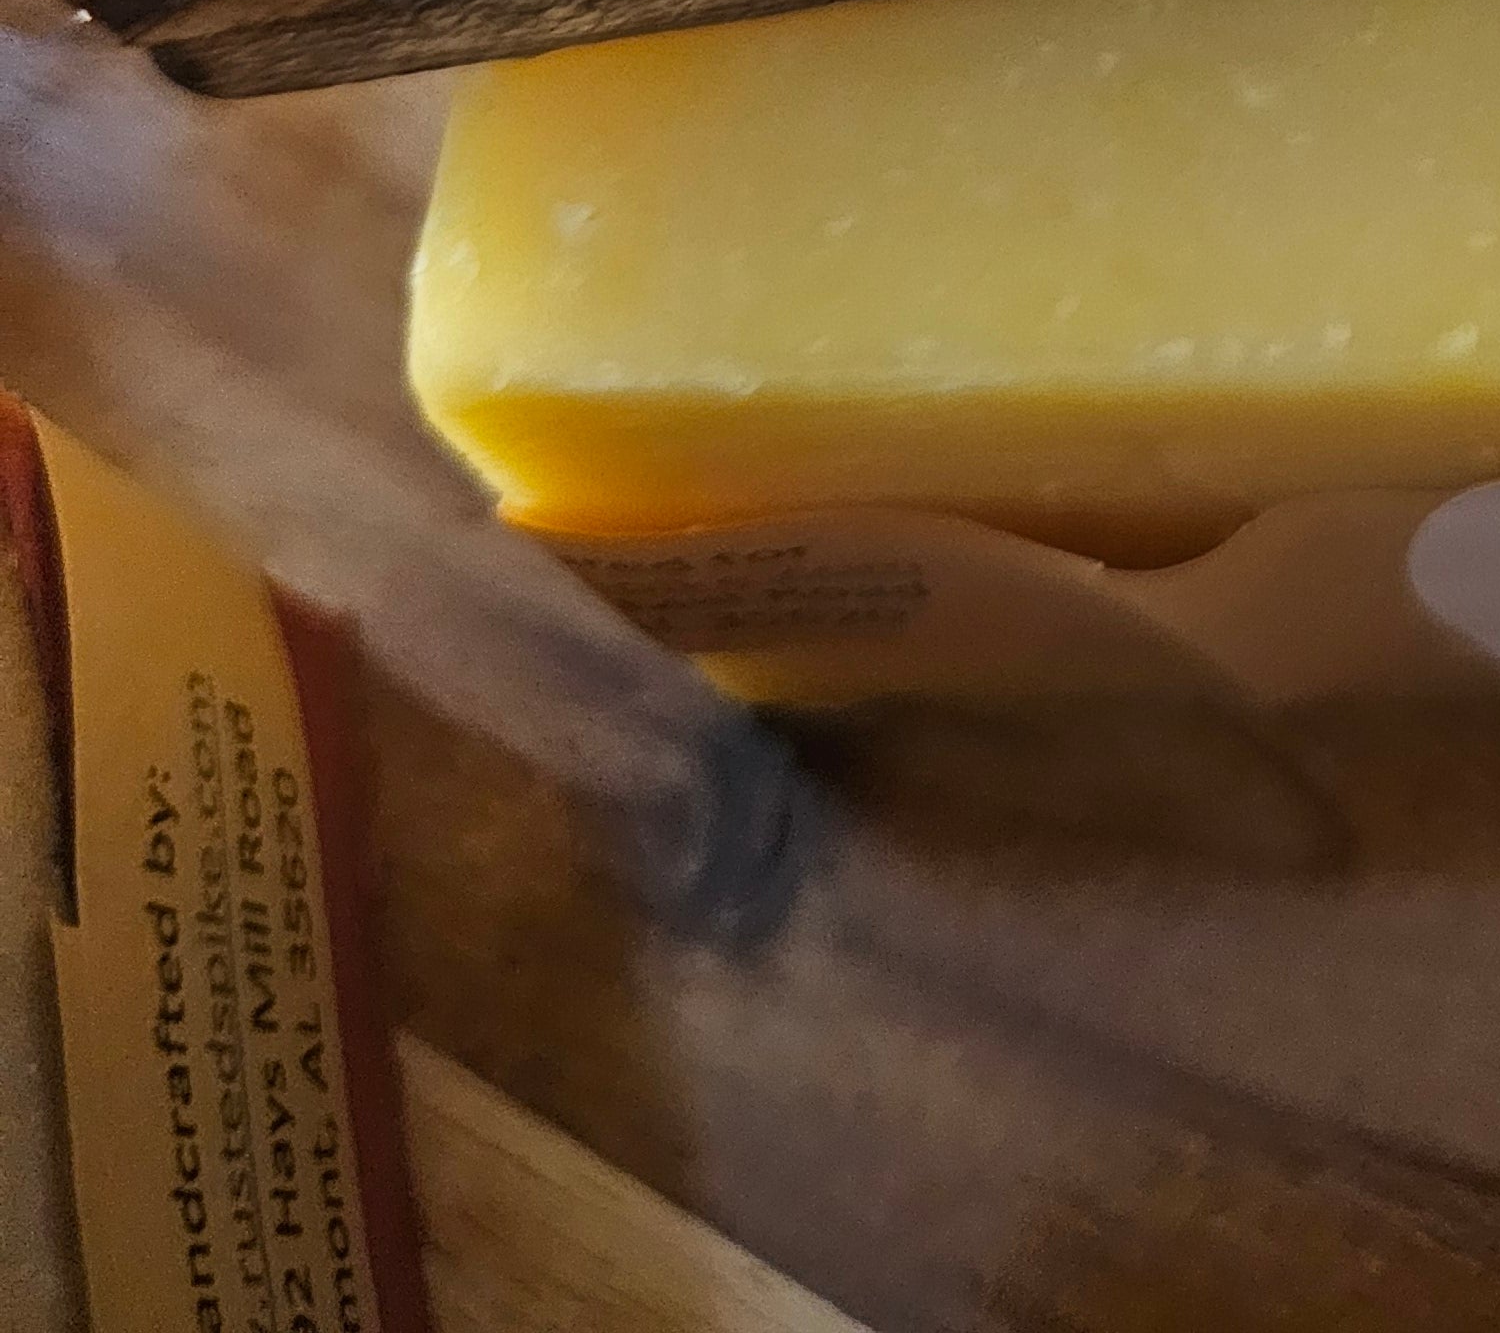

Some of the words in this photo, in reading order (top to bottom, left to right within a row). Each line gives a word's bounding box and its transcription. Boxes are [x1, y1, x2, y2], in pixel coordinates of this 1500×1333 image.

[142, 765, 180, 876] by:
[224, 699, 264, 876] Road
[240, 899, 279, 1033] Mill
[296, 1002, 329, 1092] AL
[260, 1059, 303, 1235] Hays
